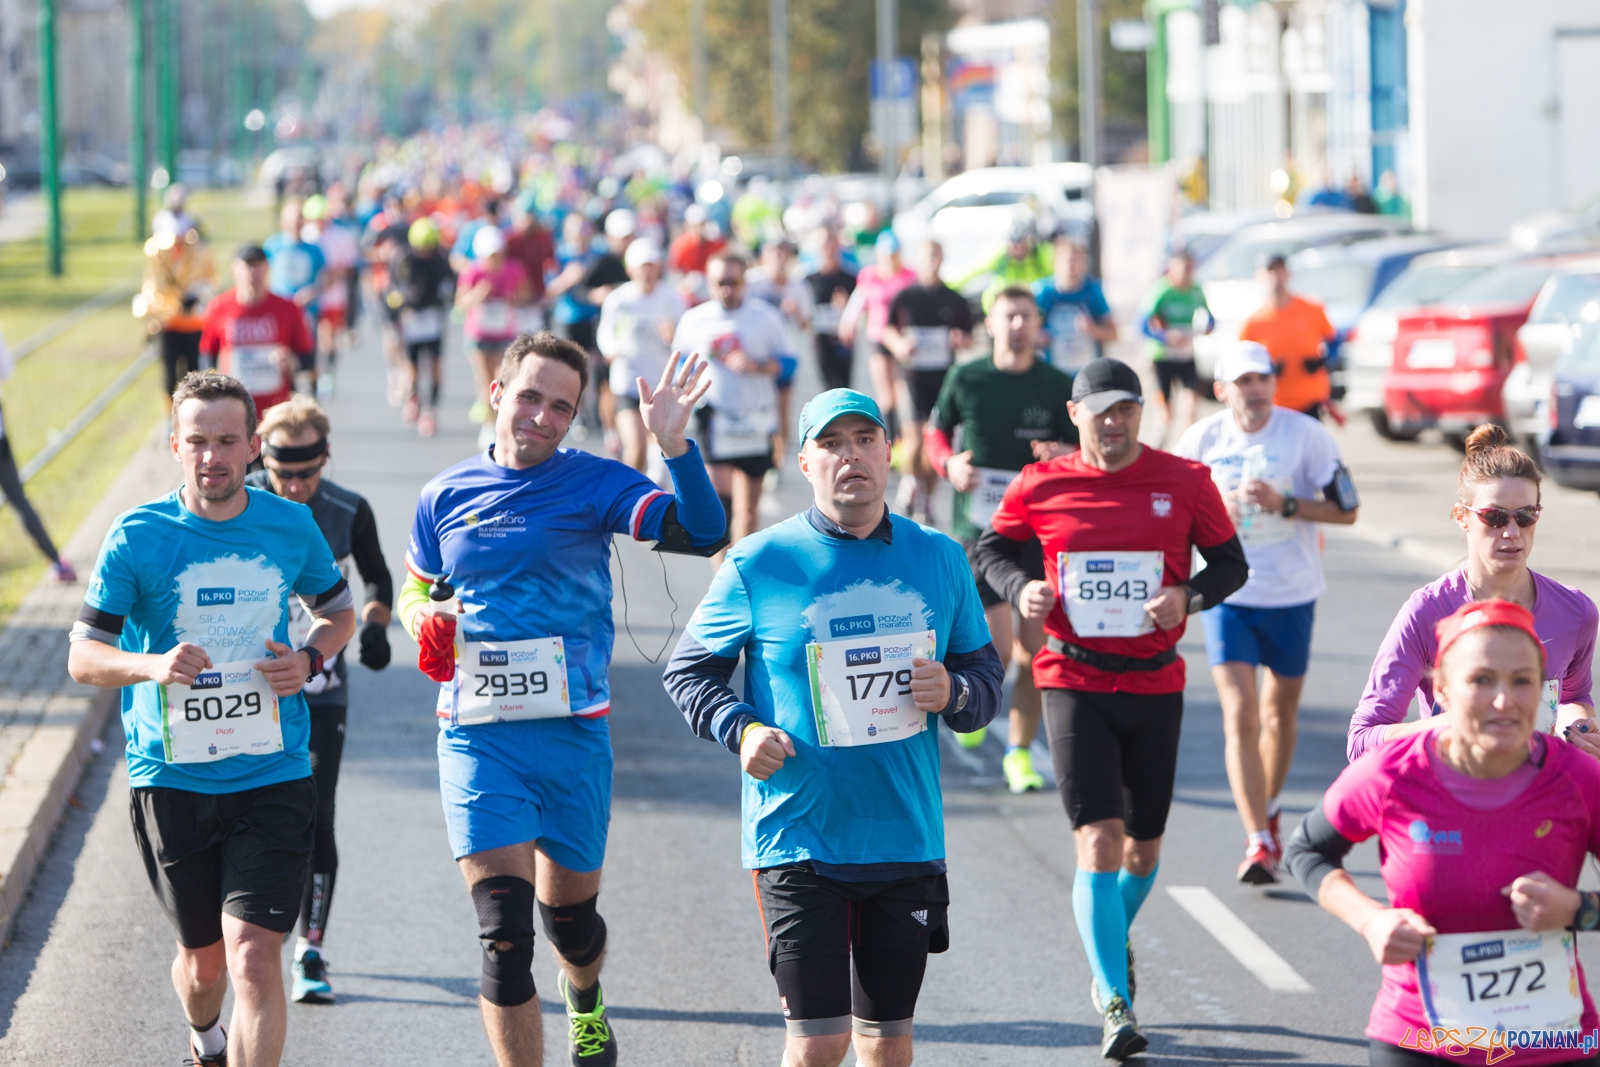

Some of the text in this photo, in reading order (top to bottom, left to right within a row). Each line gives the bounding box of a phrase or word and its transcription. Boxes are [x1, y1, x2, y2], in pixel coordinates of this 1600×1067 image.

[1079, 580, 1148, 601] 6943
[200, 592, 232, 601] 16. PKO
[199, 614, 226, 624] SIŁA
[878, 620, 913, 629] maraton
[207, 625, 260, 636] ODWAGA
[833, 620, 872, 632] 16. PKO
[491, 654, 506, 663] PKO
[848, 651, 879, 662] 16. PKO
[883, 651, 912, 659] maraton
[203, 676, 220, 685] PKO
[225, 676, 252, 684] maraton
[474, 671, 548, 697] 2939
[846, 669, 913, 701] 1779
[184, 691, 261, 722] 6029
[871, 705, 898, 716] Paweł
[215, 727, 235, 735] Piotr
[910, 911, 928, 926] adidas
[1479, 943, 1502, 957] PKO
[1461, 960, 1546, 1002] 1272
